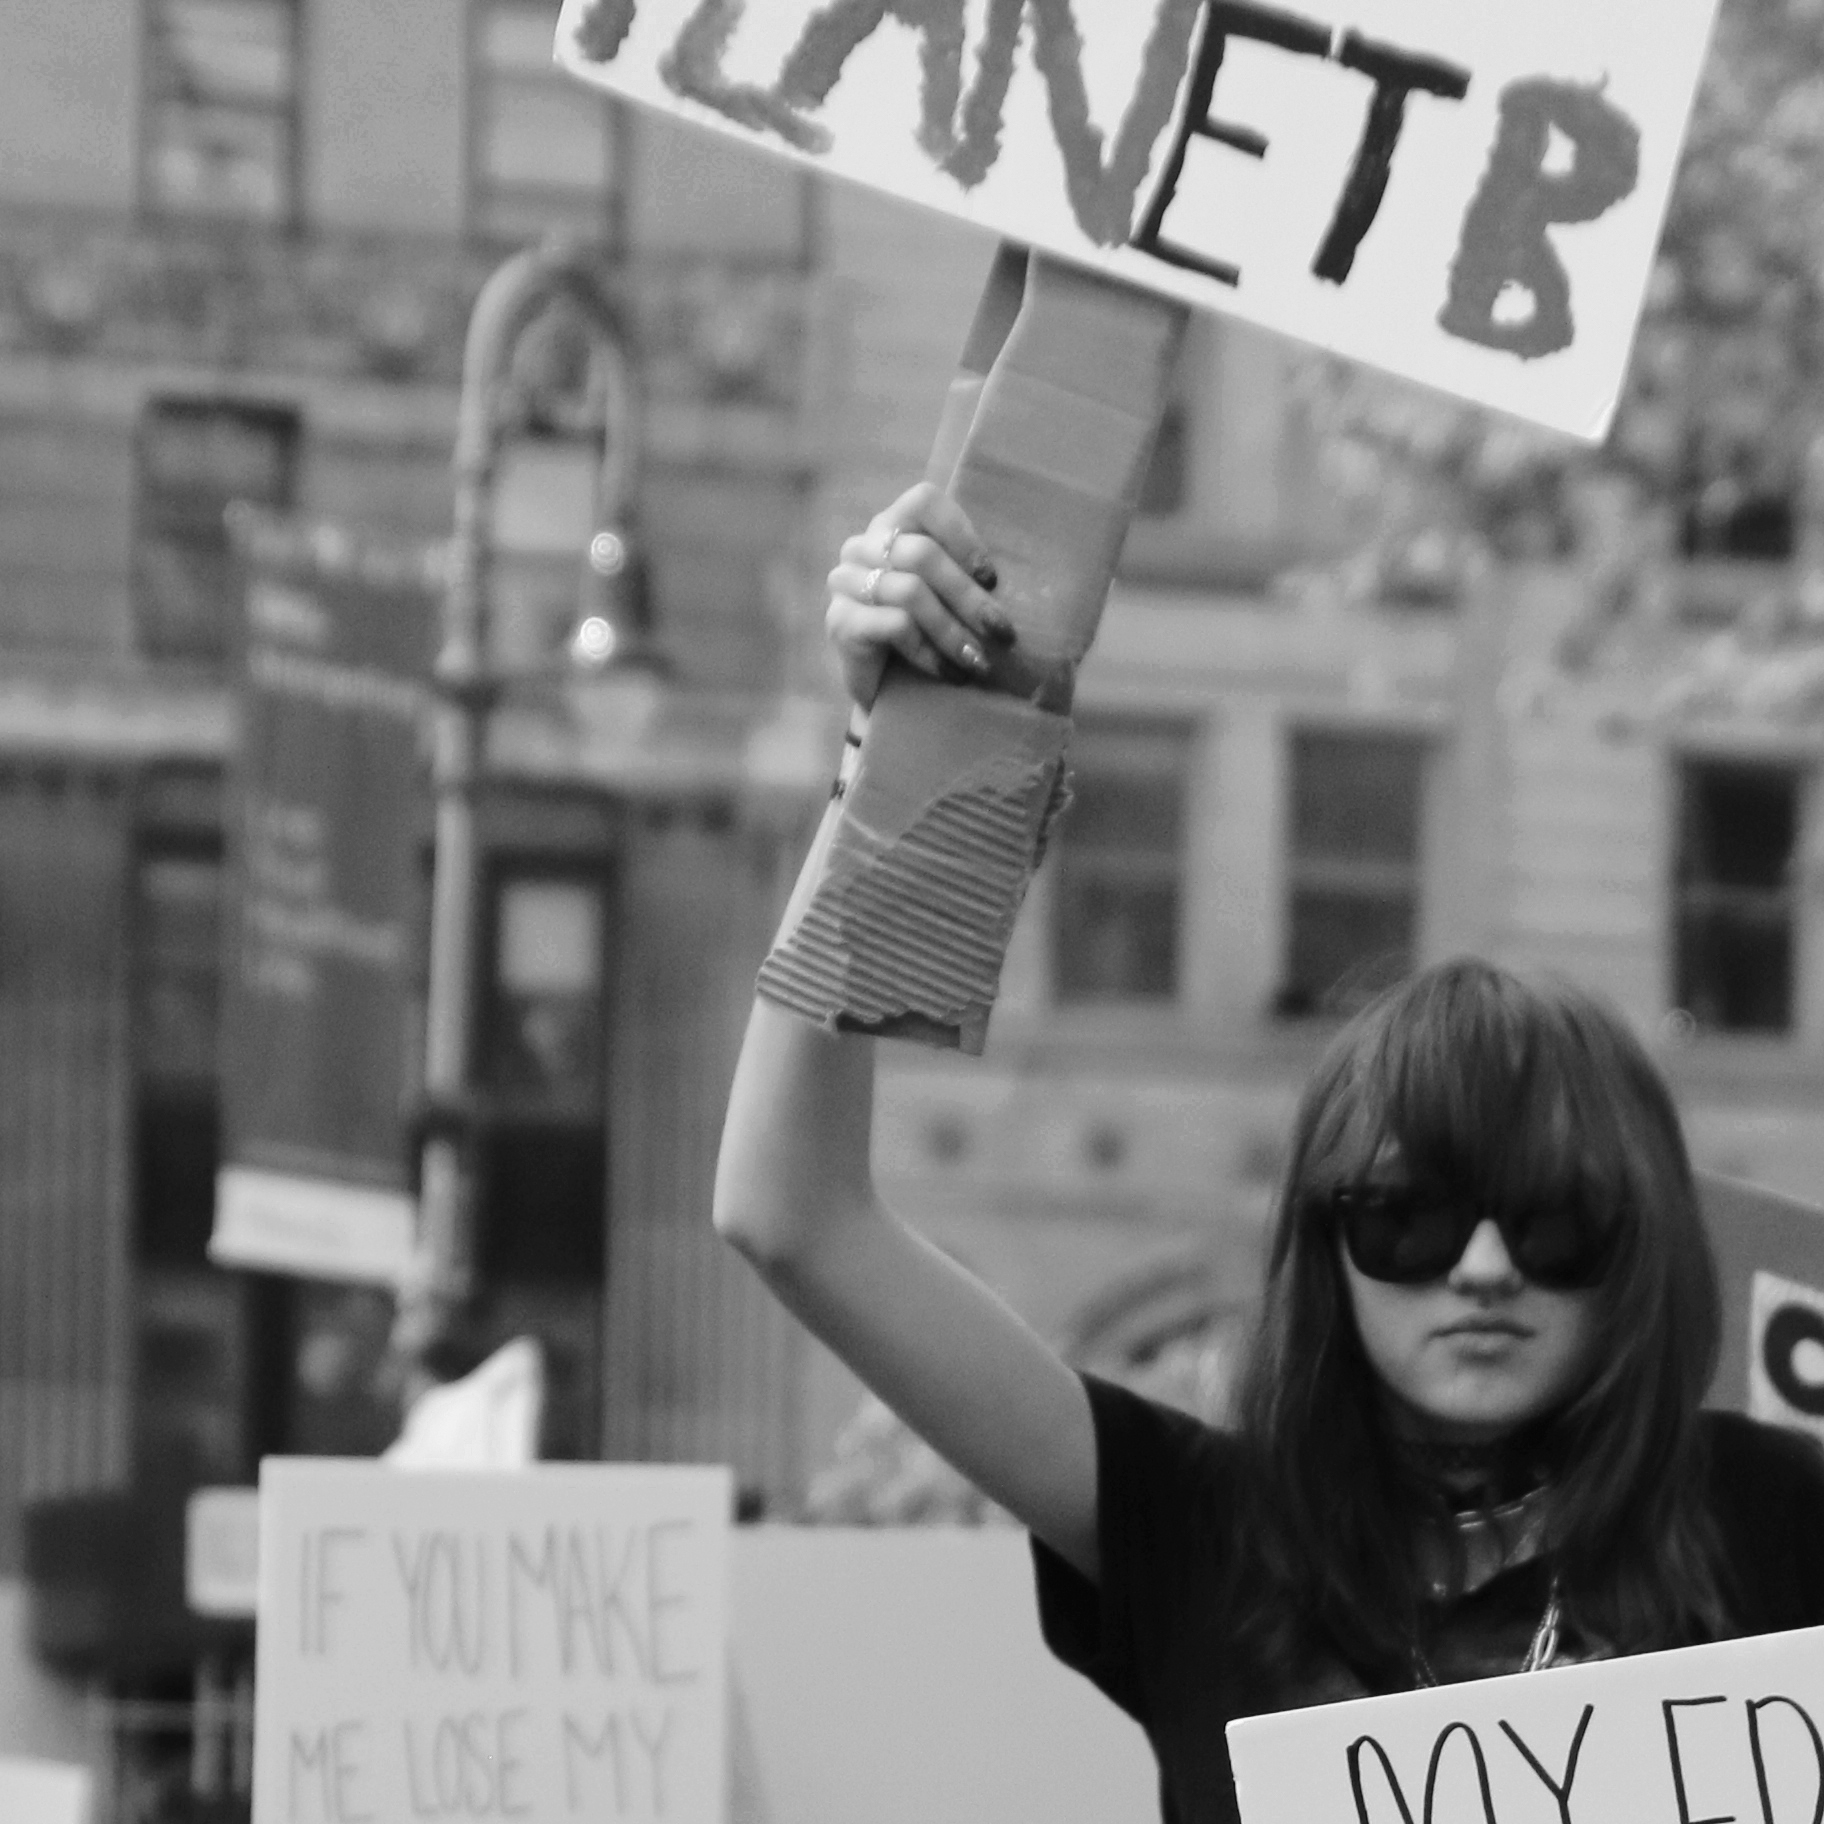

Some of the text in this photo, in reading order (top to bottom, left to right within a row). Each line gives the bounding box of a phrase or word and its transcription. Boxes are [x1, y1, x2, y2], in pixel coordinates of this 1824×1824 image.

[1437, 69, 1642, 362] B
[299, 1518, 699, 1688] IF YOU MAKE
[403, 1707, 534, 1820] LOSE
[563, 1706, 674, 1819] MY
